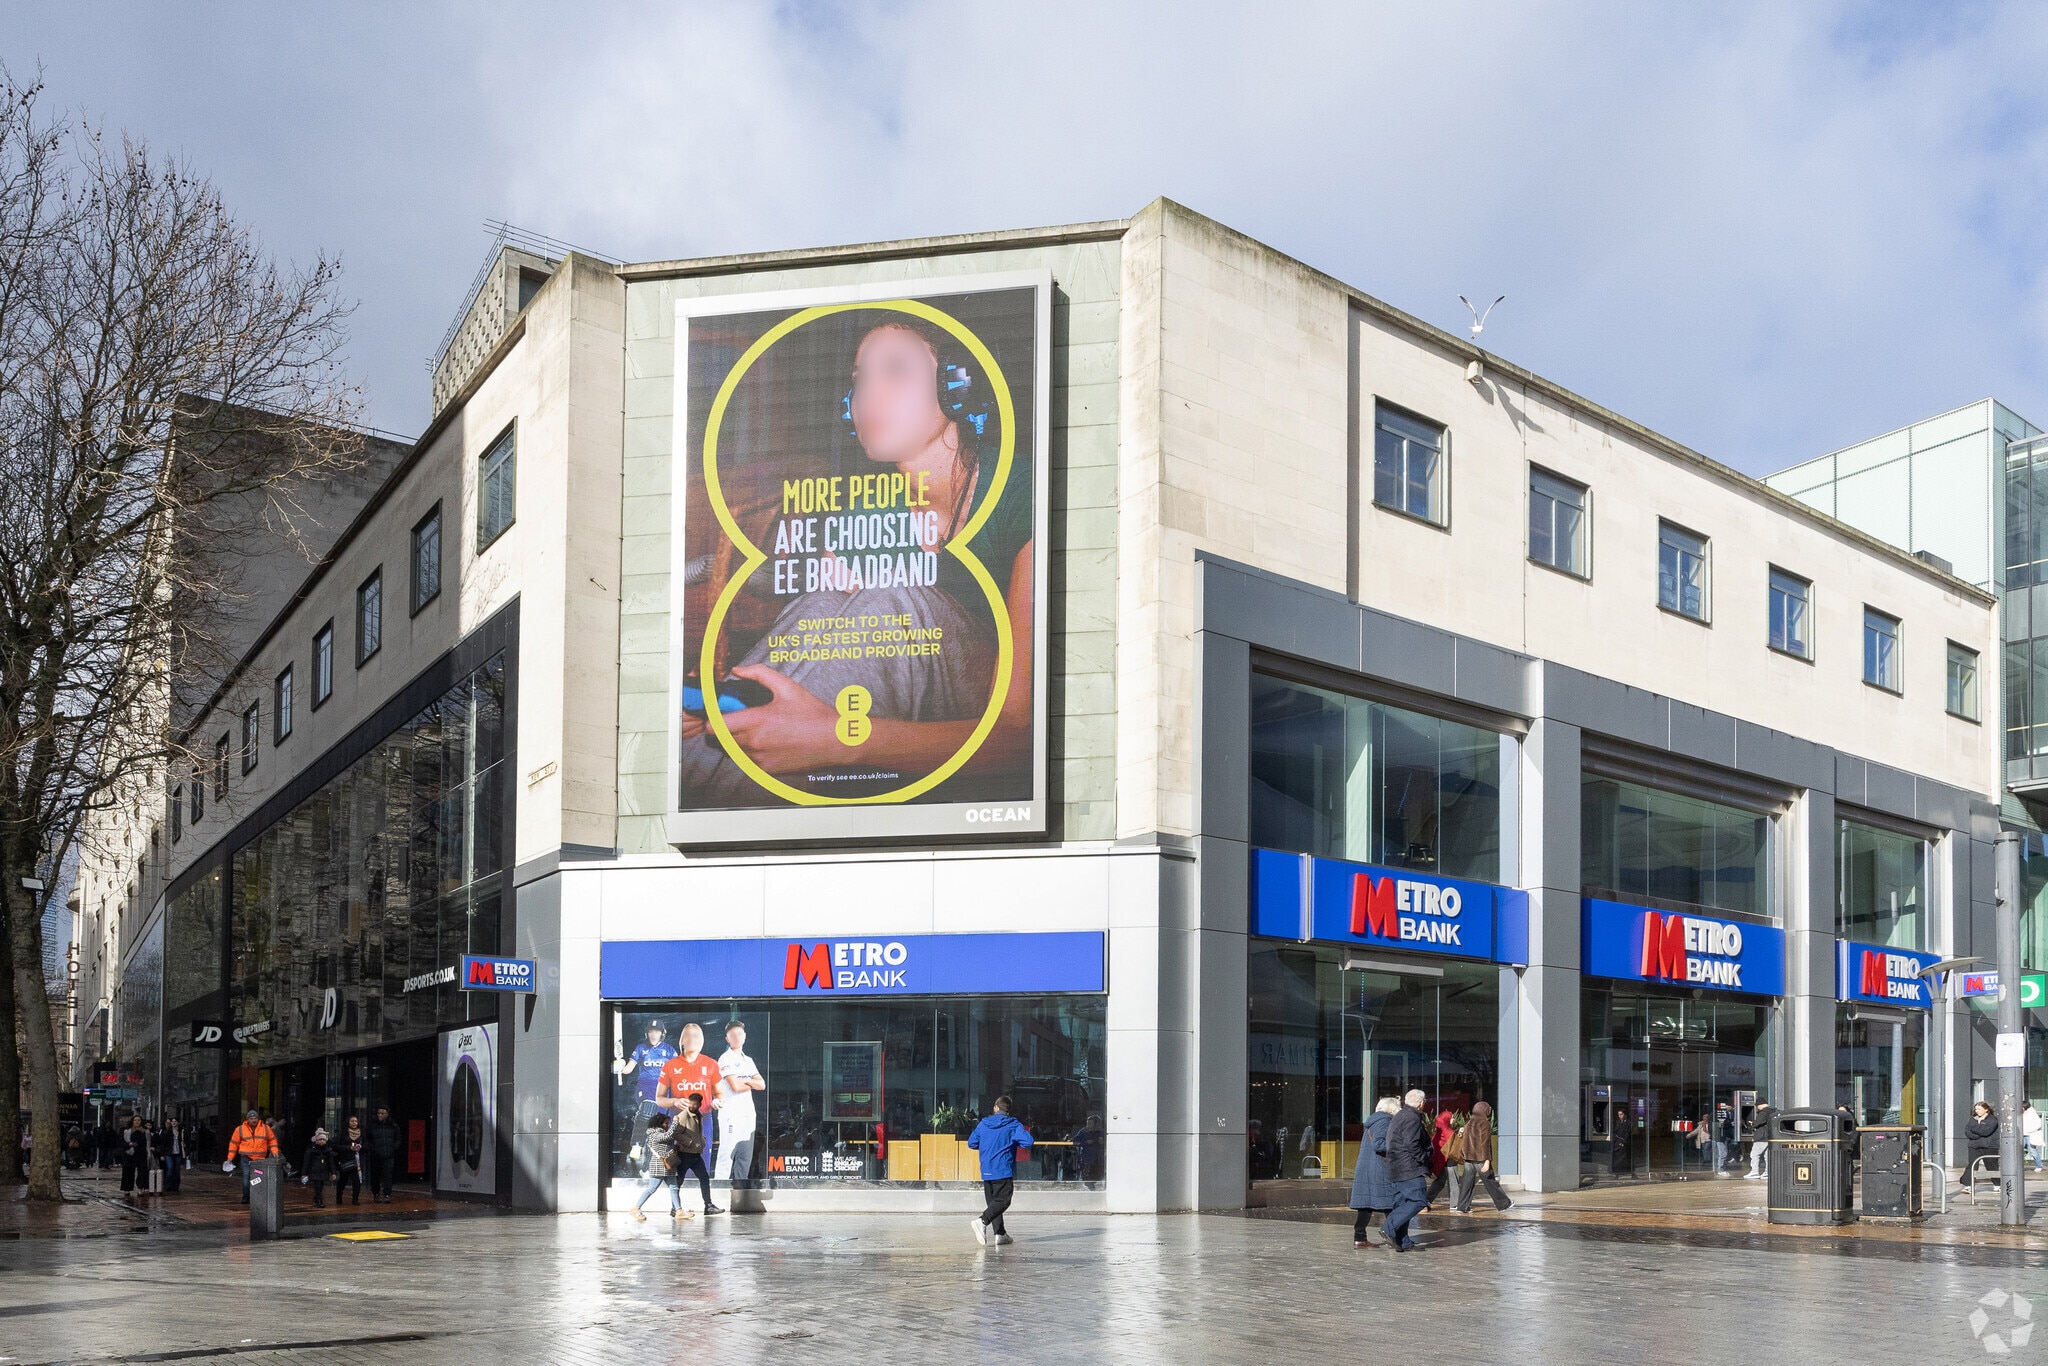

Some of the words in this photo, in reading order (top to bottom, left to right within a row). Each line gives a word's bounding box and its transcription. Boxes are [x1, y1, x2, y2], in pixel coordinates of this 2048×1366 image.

[783, 476, 842, 515] MORE
[850, 470, 930, 511] PEOPLE
[774, 518, 818, 555] ARE
[825, 510, 938, 552] CHOOSING
[774, 559, 800, 595] EE
[806, 551, 937, 593] BROADBAND
[798, 616, 855, 631] SWITCH
[859, 615, 879, 628] TO
[882, 613, 912, 627] THE
[803, 631, 870, 645] FASTEST
[872, 627, 943, 643] GROWING
[769, 648, 862, 663] BROADBAND
[865, 643, 941, 658] PROVIDER
[816, 775, 836, 783] verify
[849, 772, 899, 781] ee.co.uk/claims
[965, 807, 1031, 823] OCEAN
[1350, 872, 1462, 938] METRO
[1400, 917, 1462, 946] BANK
[1641, 911, 1742, 981] METRO
[469, 961, 530, 985] METRO
[783, 942, 908, 989] METRO
[1686, 957, 1742, 987] BANK
[1862, 950, 1921, 997] METRO
[403, 965, 456, 993] JDSPORTS.CO.UK
[496, 976, 529, 986] BANK
[838, 970, 908, 989] BANK
[1966, 975, 1998, 992] MET
[1887, 981, 1921, 1001] BANK
[320, 987, 337, 1030] JD
[195, 1026, 222, 1042] JD
[677, 1079, 706, 1091] cinch
[768, 1156, 810, 1172] METRO
